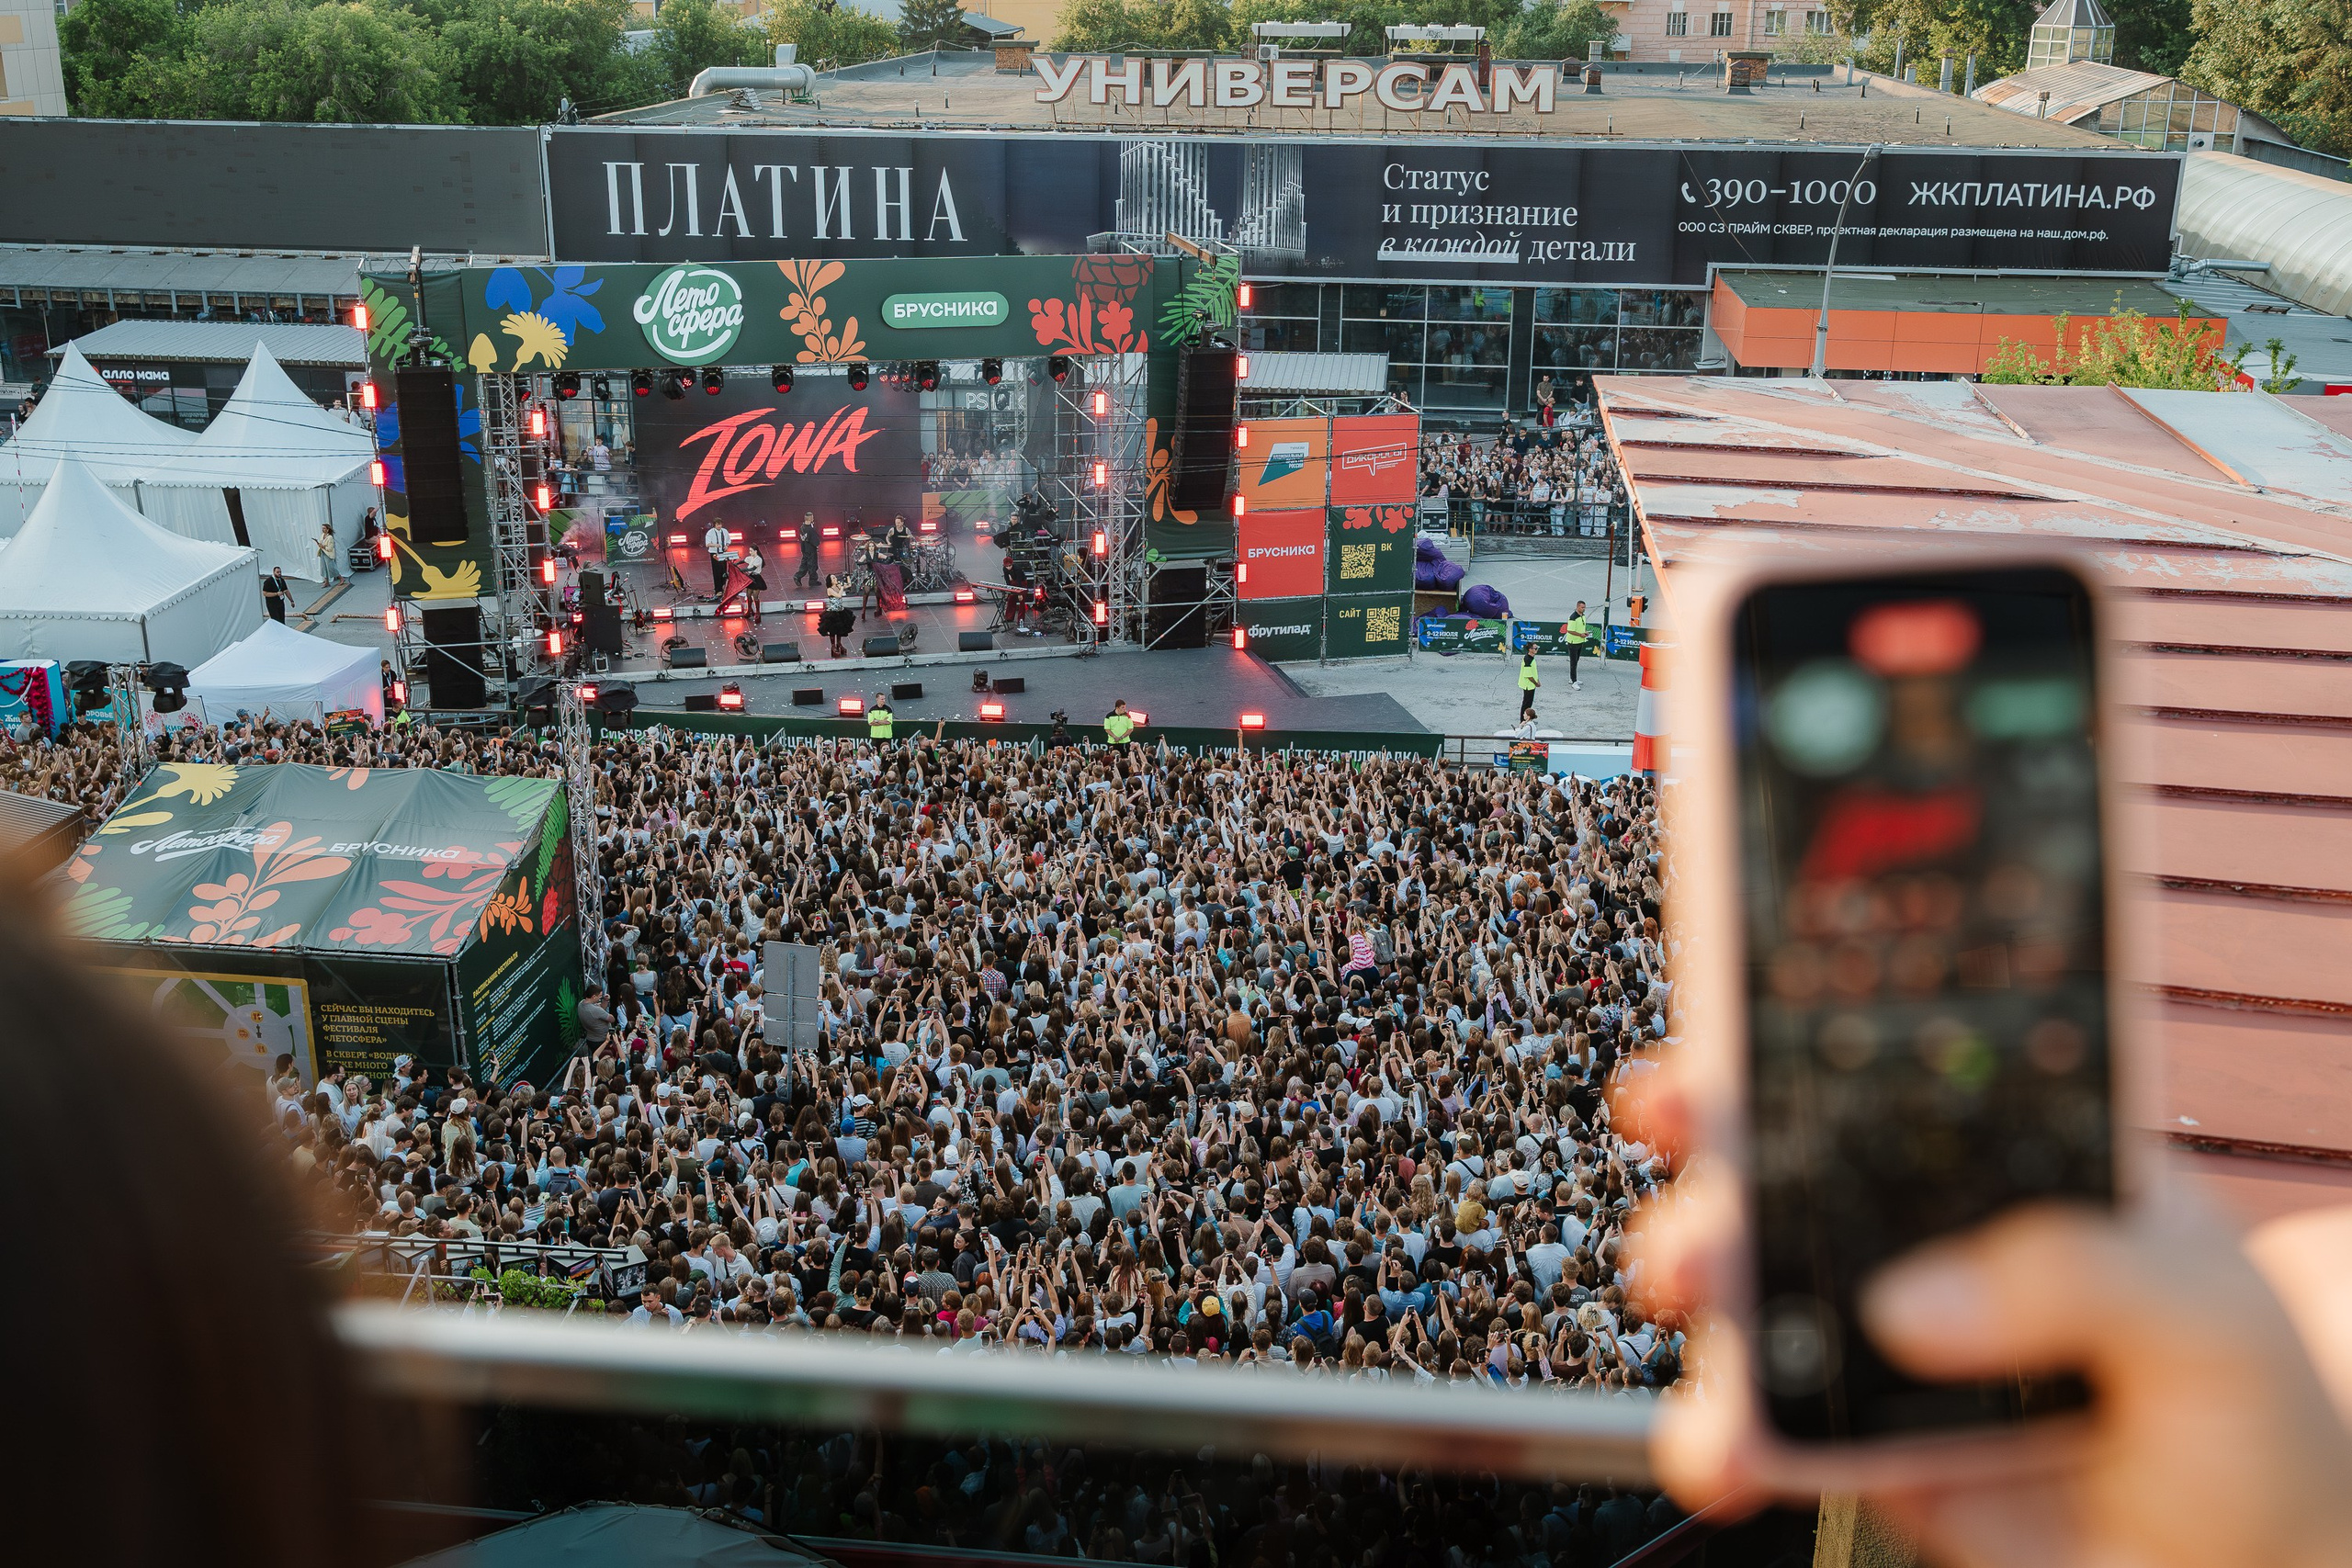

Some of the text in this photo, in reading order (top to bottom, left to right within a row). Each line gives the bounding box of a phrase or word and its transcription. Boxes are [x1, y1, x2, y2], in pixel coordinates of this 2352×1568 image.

[1028, 53, 1558, 115] УНИВЕРСАМ
[1384, 163, 1489, 196] Статус
[602, 162, 967, 242] ПЛАТИНА
[1908, 182, 2156, 210] ЖКПЛАТИНА.РФ
[1382, 204, 1577, 229] и признание
[1679, 222, 1706, 232] ООО
[1709, 222, 1725, 233] СЗ
[1728, 221, 1770, 234] ПРАЙМ
[1773, 223, 1814, 236] СКВЕР,
[1879, 227, 1948, 238] декларация
[1951, 227, 2017, 239] размещена
[2019, 229, 2033, 238] на
[2037, 230, 2109, 241] наш.дом.рф.
[1380, 231, 1636, 265] в каждой детали
[633, 270, 719, 324] Лето
[668, 303, 745, 349] сфера
[676, 404, 886, 523] IOWA
[1381, 543, 1392, 551] ВК
[1339, 609, 1362, 618] САЙТ
[321, 1003, 356, 1013] СЕЙЧАС
[375, 1007, 435, 1017] НАХОДИТЕСЬ
[330, 1014, 373, 1024] ГЛАВНОЙ
[375, 1017, 408, 1025] СЦЕНЫ
[322, 1024, 379, 1033] ФЕСТИВАЛЯ
[324, 1034, 387, 1043] «ЛЕТОСФЕРА»
[334, 1051, 367, 1059] СКВЕРЕ
